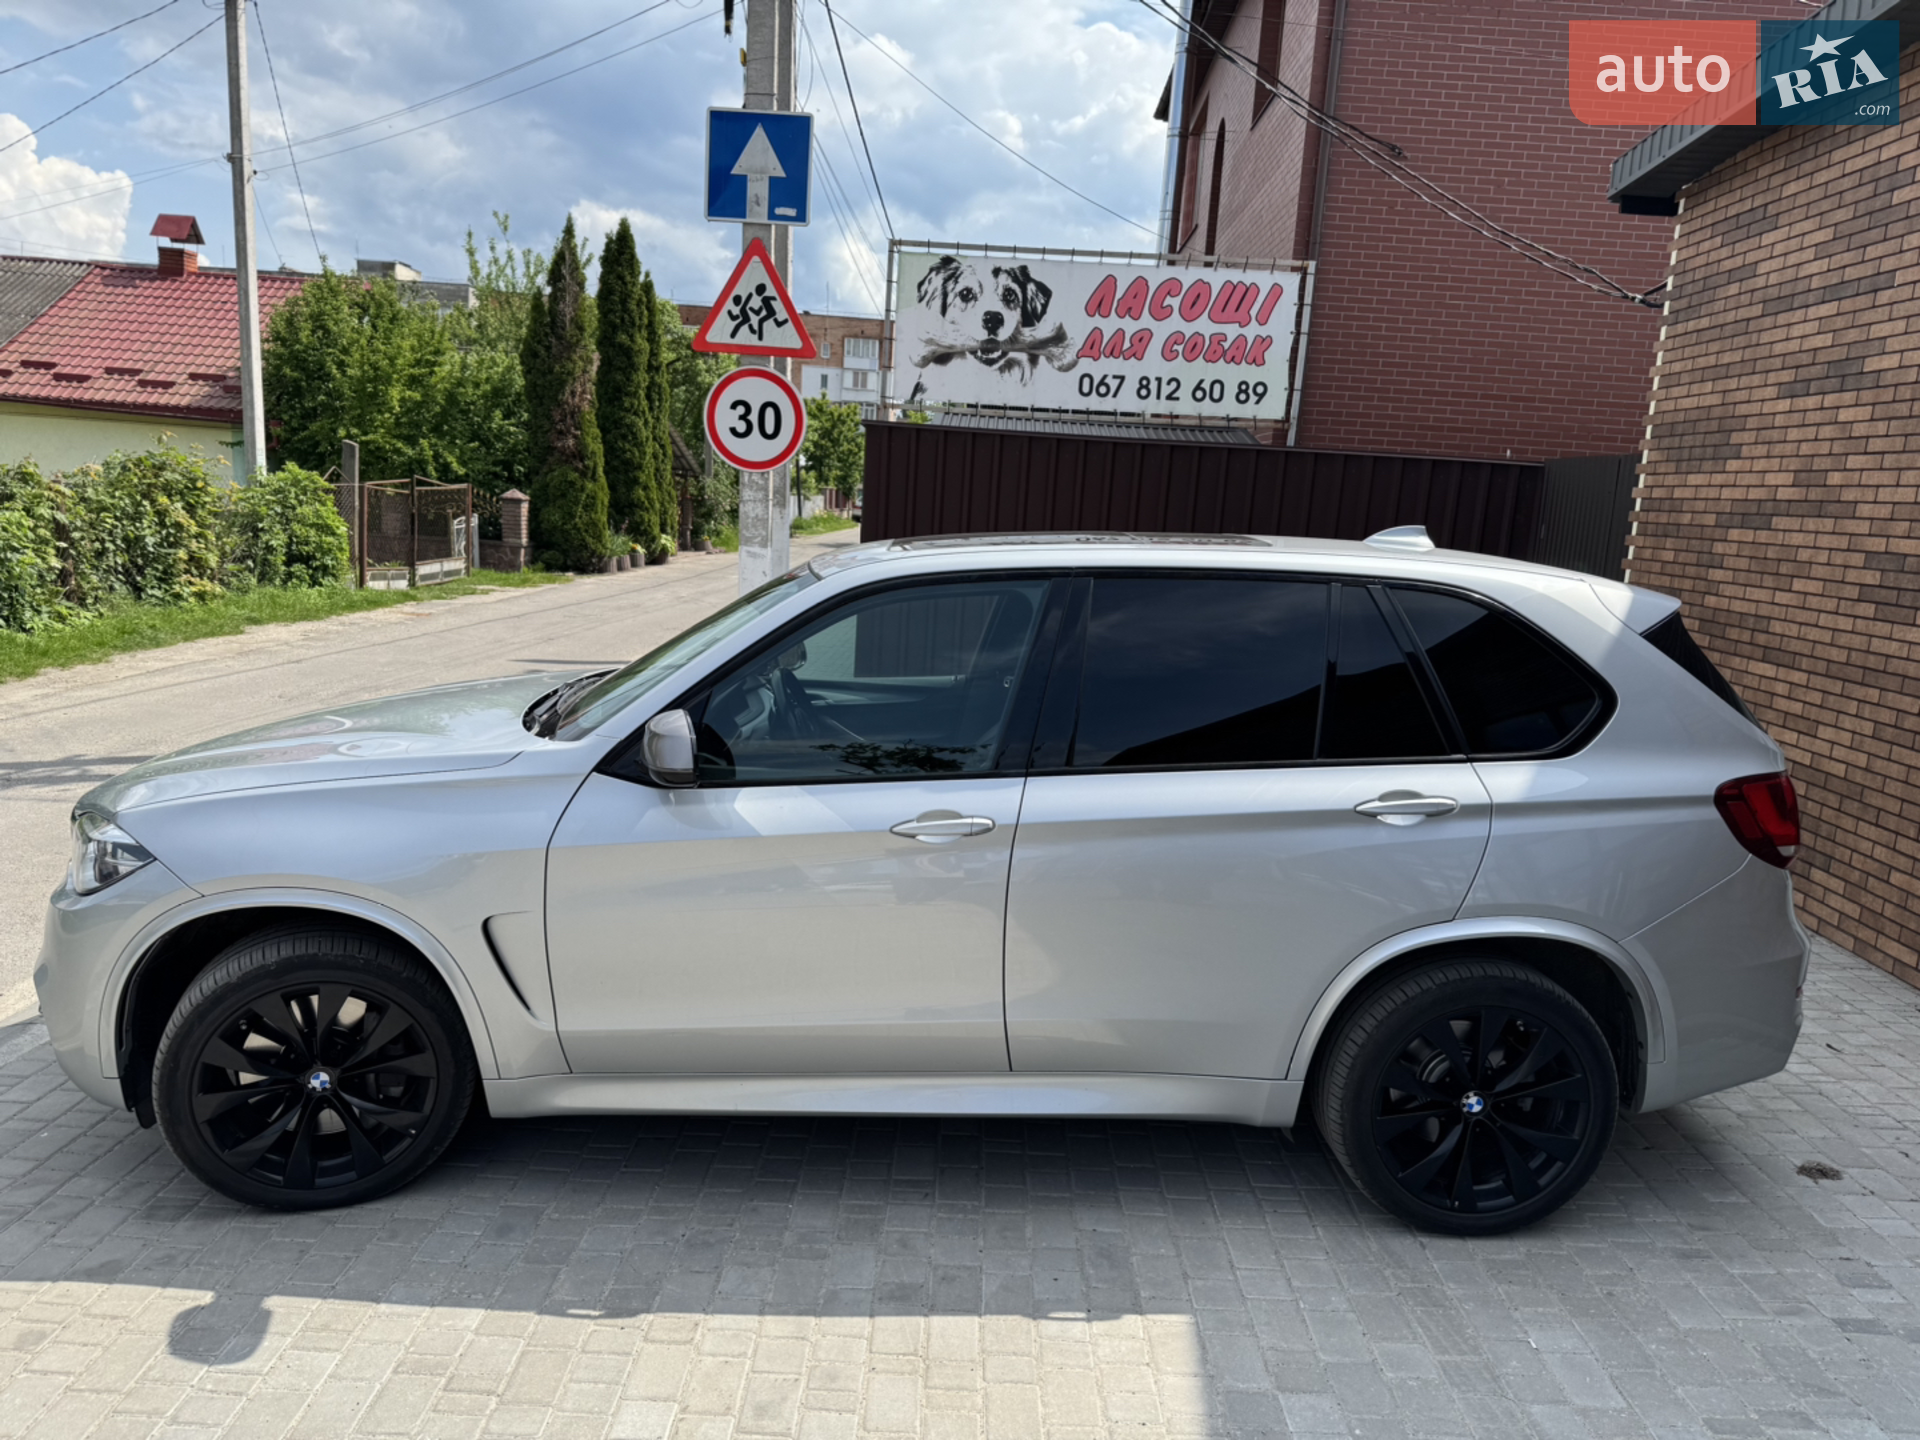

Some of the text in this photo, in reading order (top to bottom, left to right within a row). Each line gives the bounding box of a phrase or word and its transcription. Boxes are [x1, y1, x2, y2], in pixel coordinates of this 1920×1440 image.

[1085, 274, 1284, 328] ЛАСОЩІ
[1077, 328, 1273, 366] ДЛЯ СОБАК
[1078, 372, 1269, 405] 067 812 60 89
[728, 399, 783, 441] 30
